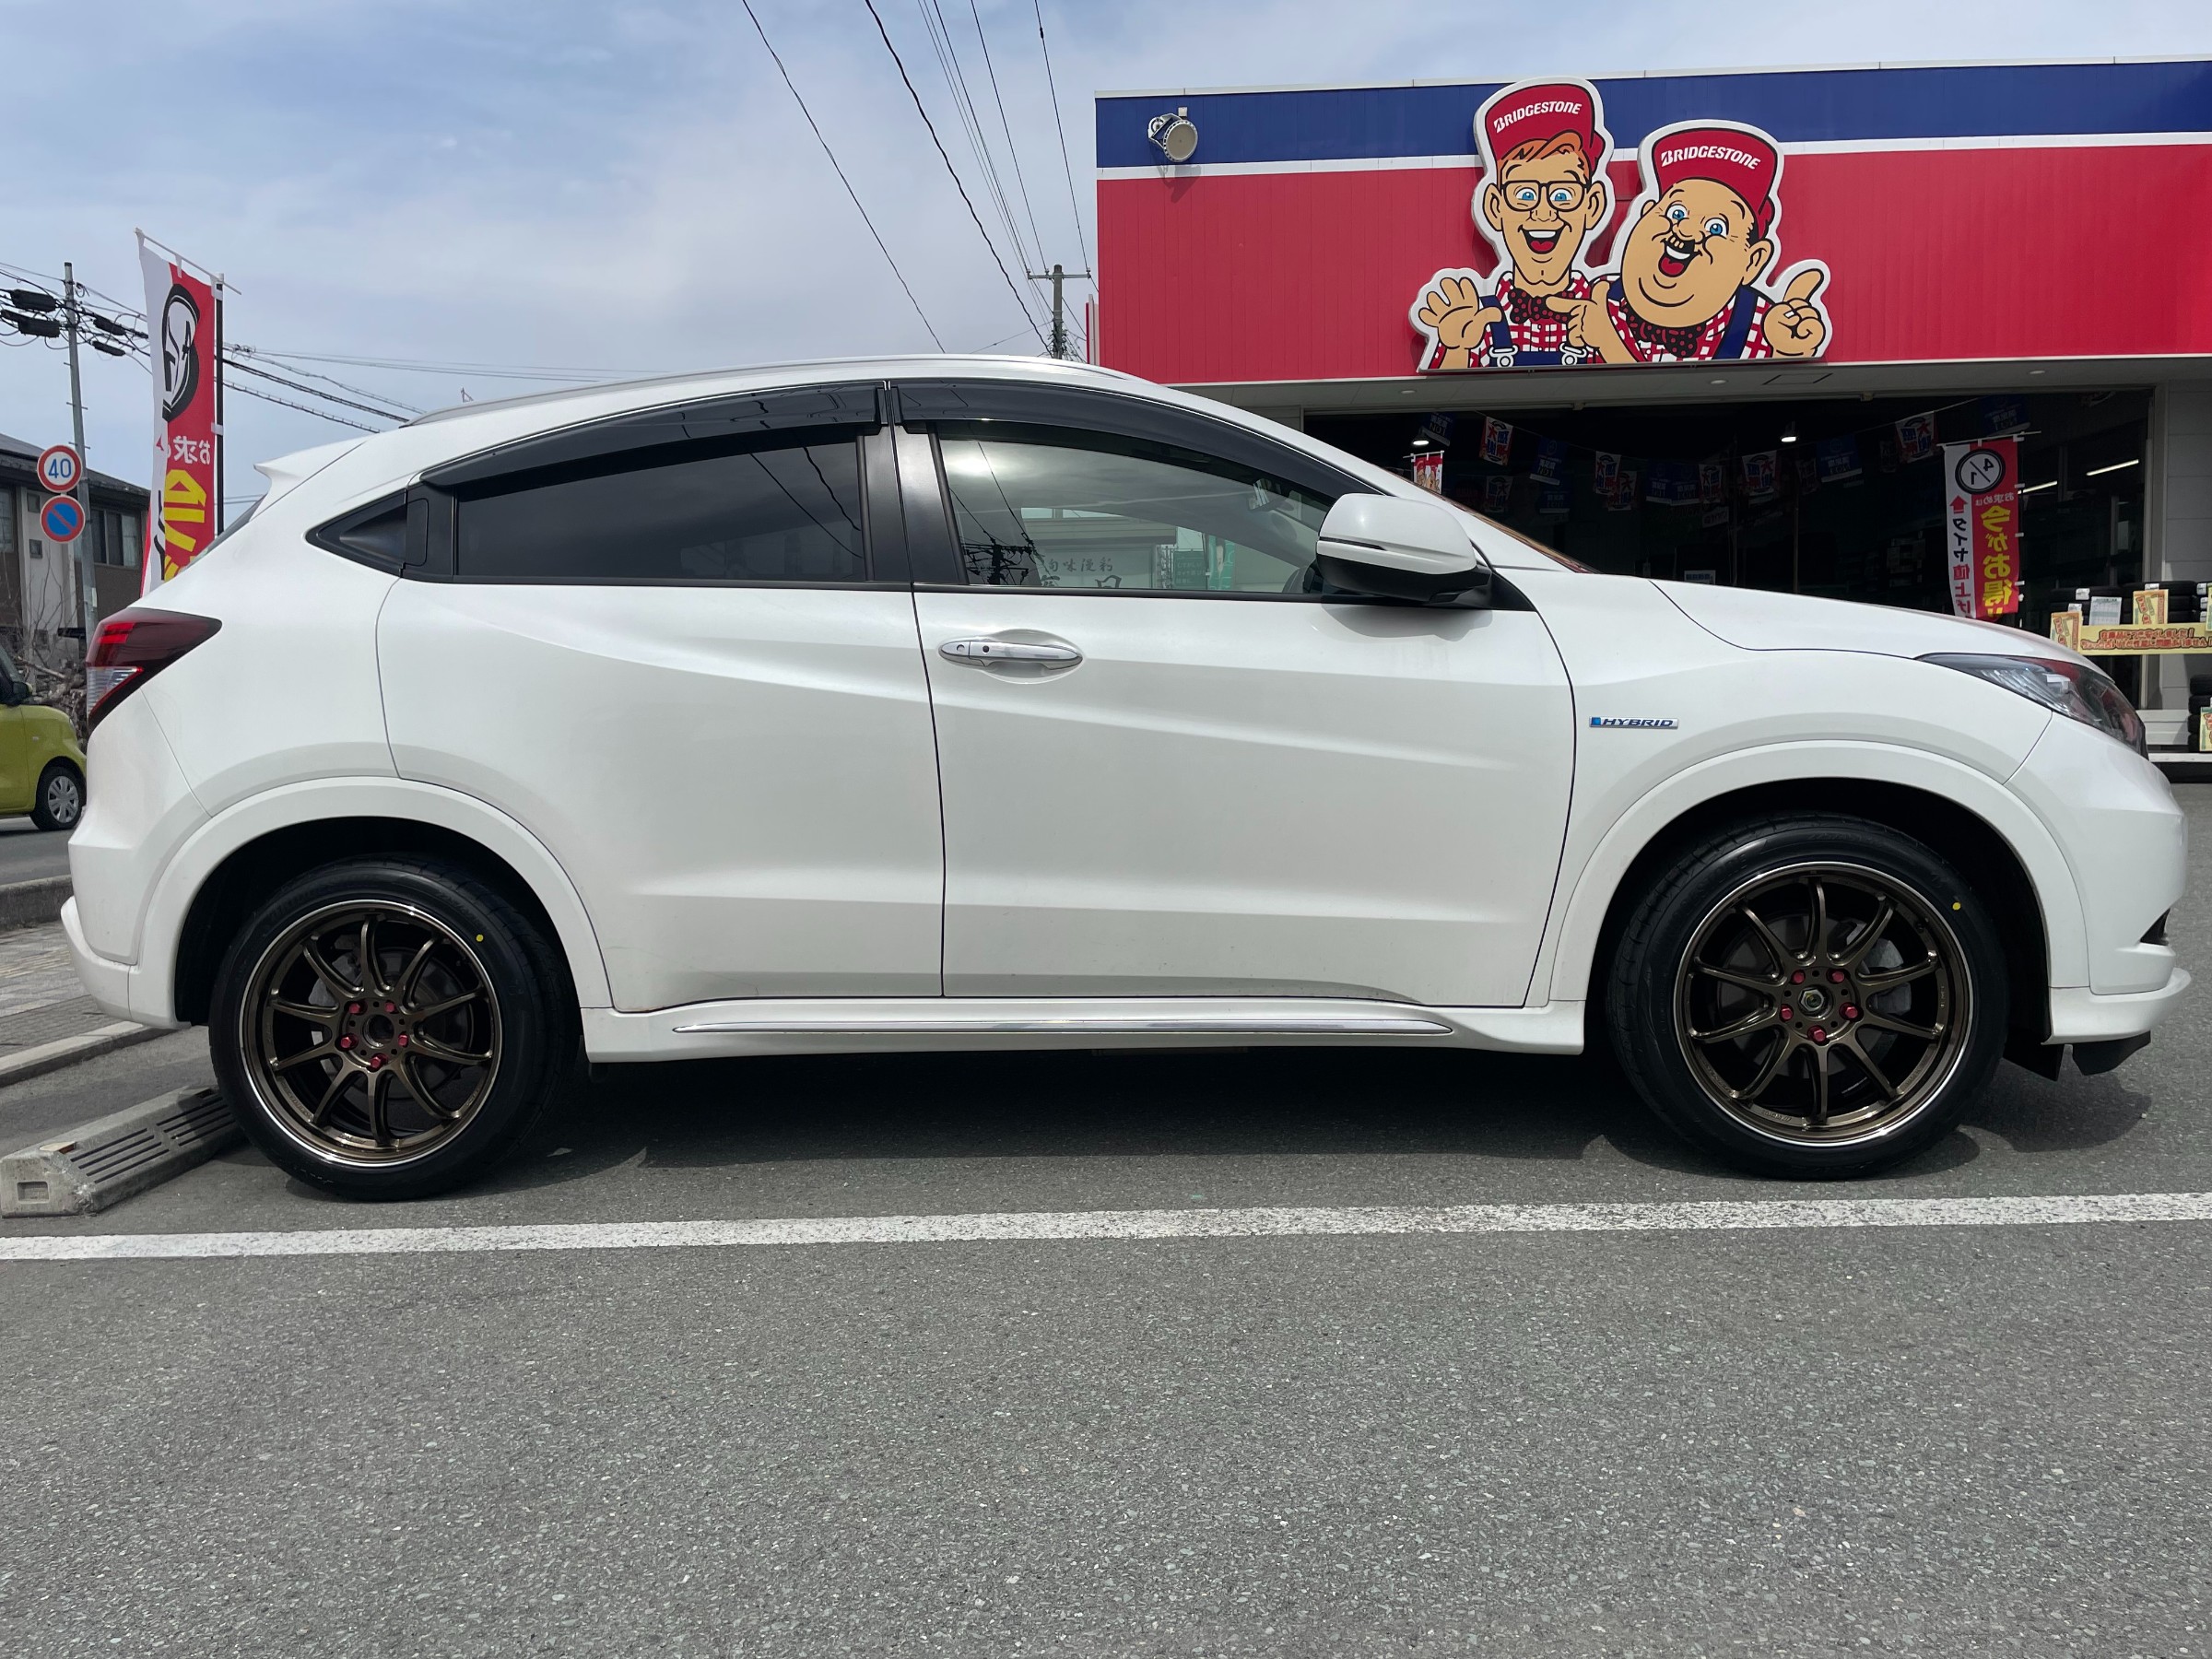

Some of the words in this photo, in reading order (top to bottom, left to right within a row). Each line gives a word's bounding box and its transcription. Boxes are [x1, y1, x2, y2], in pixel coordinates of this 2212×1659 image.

[1493, 100, 1583, 134] BRIDGESTONE
[1661, 145, 1761, 170] BRIDGESTONE
[48, 457, 72, 478] 40
[1602, 718, 1674, 727] HYBRID
